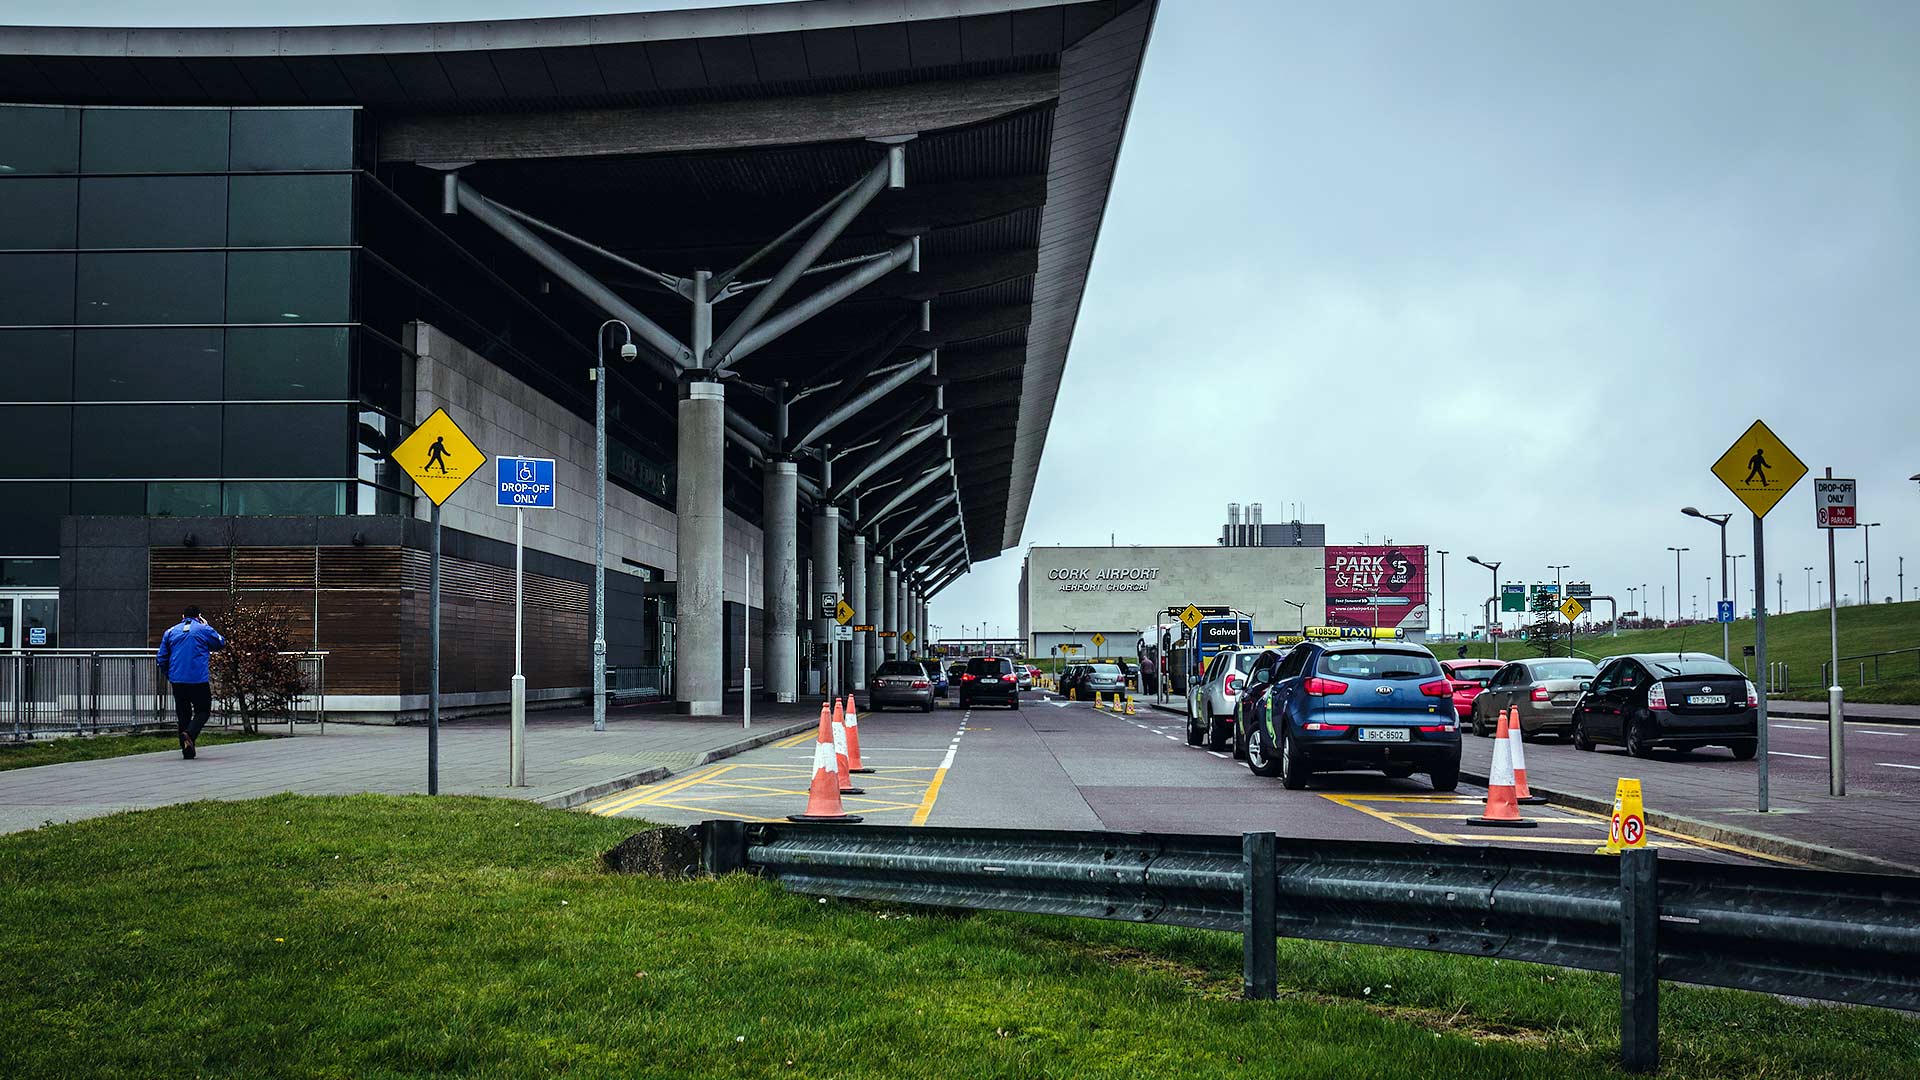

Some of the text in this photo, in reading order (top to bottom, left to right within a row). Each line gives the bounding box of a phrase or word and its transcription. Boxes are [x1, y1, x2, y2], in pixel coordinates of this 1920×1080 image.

[501, 482, 550, 494] DROP-OFF
[1818, 483, 1853, 493] DROP-OFF
[513, 493, 538, 504] ONLY
[1827, 494, 1845, 503] ONLY
[1836, 508, 1846, 516] NO
[1830, 516, 1853, 525] PARKING
[1335, 556, 1385, 572] PARK
[1392, 560, 1408, 575] €5
[1048, 567, 1160, 581] CORK AIRPORT
[1335, 571, 1384, 587] & FLY
[1058, 582, 1102, 592] AERFORT
[1722, 612, 1730, 621] P
[1314, 628, 1338, 636] 10852
[1341, 627, 1371, 637] TAXI
[1395, 628, 1402, 637] C
[1368, 730, 1404, 740] 151-C-8502
